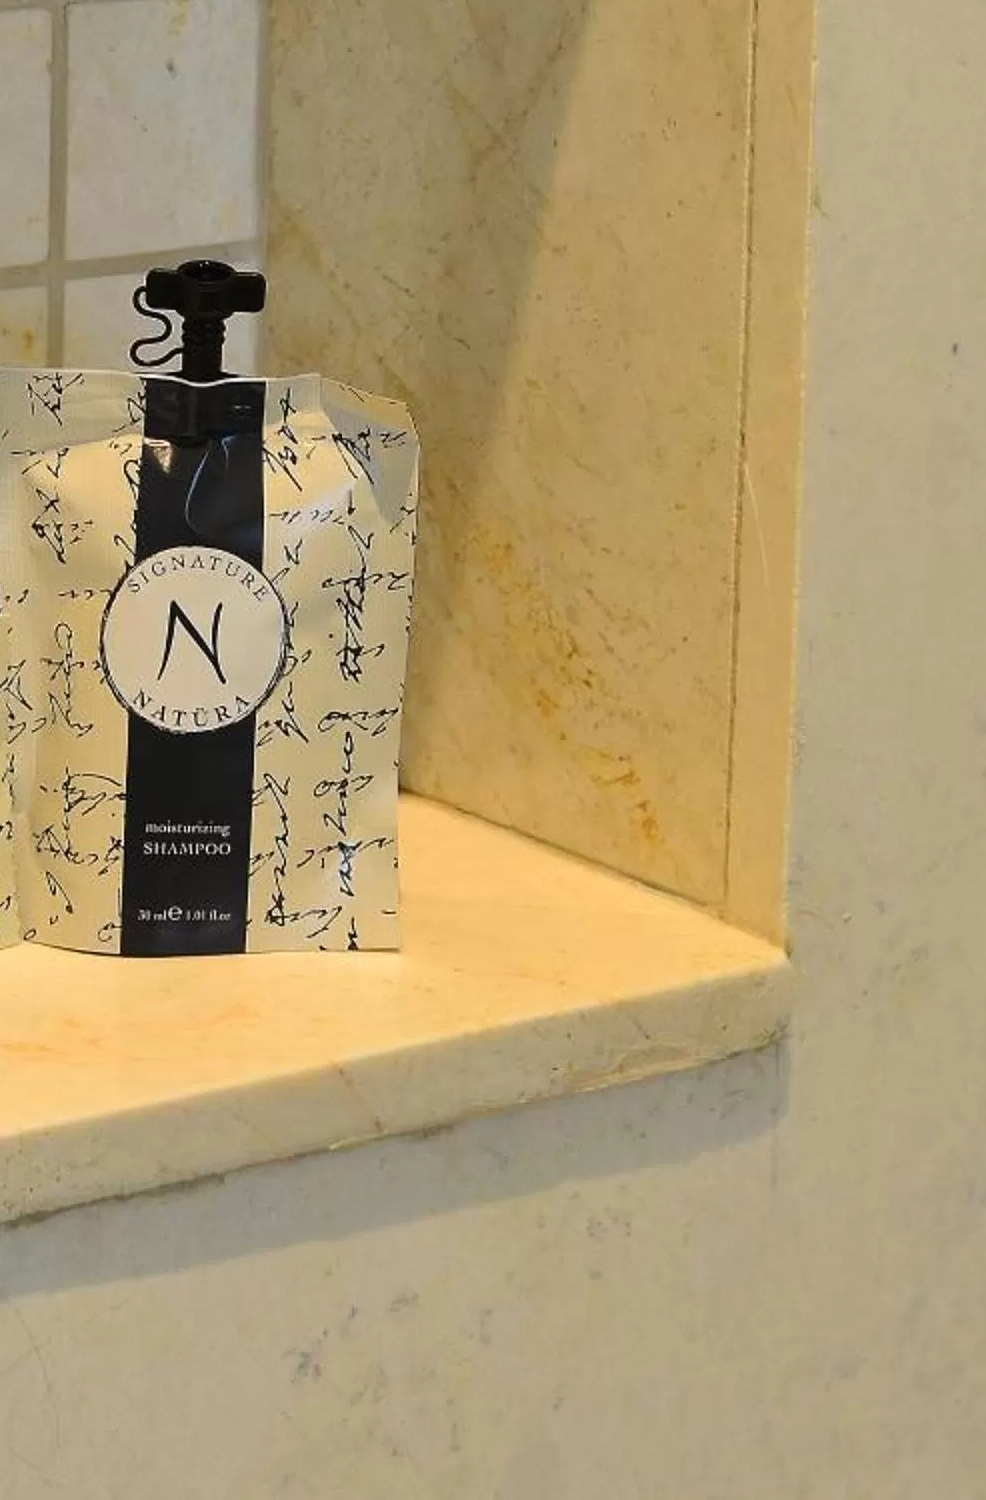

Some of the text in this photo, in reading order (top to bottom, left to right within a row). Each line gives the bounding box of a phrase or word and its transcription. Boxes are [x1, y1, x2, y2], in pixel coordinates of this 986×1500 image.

[127, 554, 268, 601] SIGNATURE
[156, 599, 227, 685] N
[144, 819, 231, 838] moisturizing
[142, 841, 232, 856] SHAMPOO
